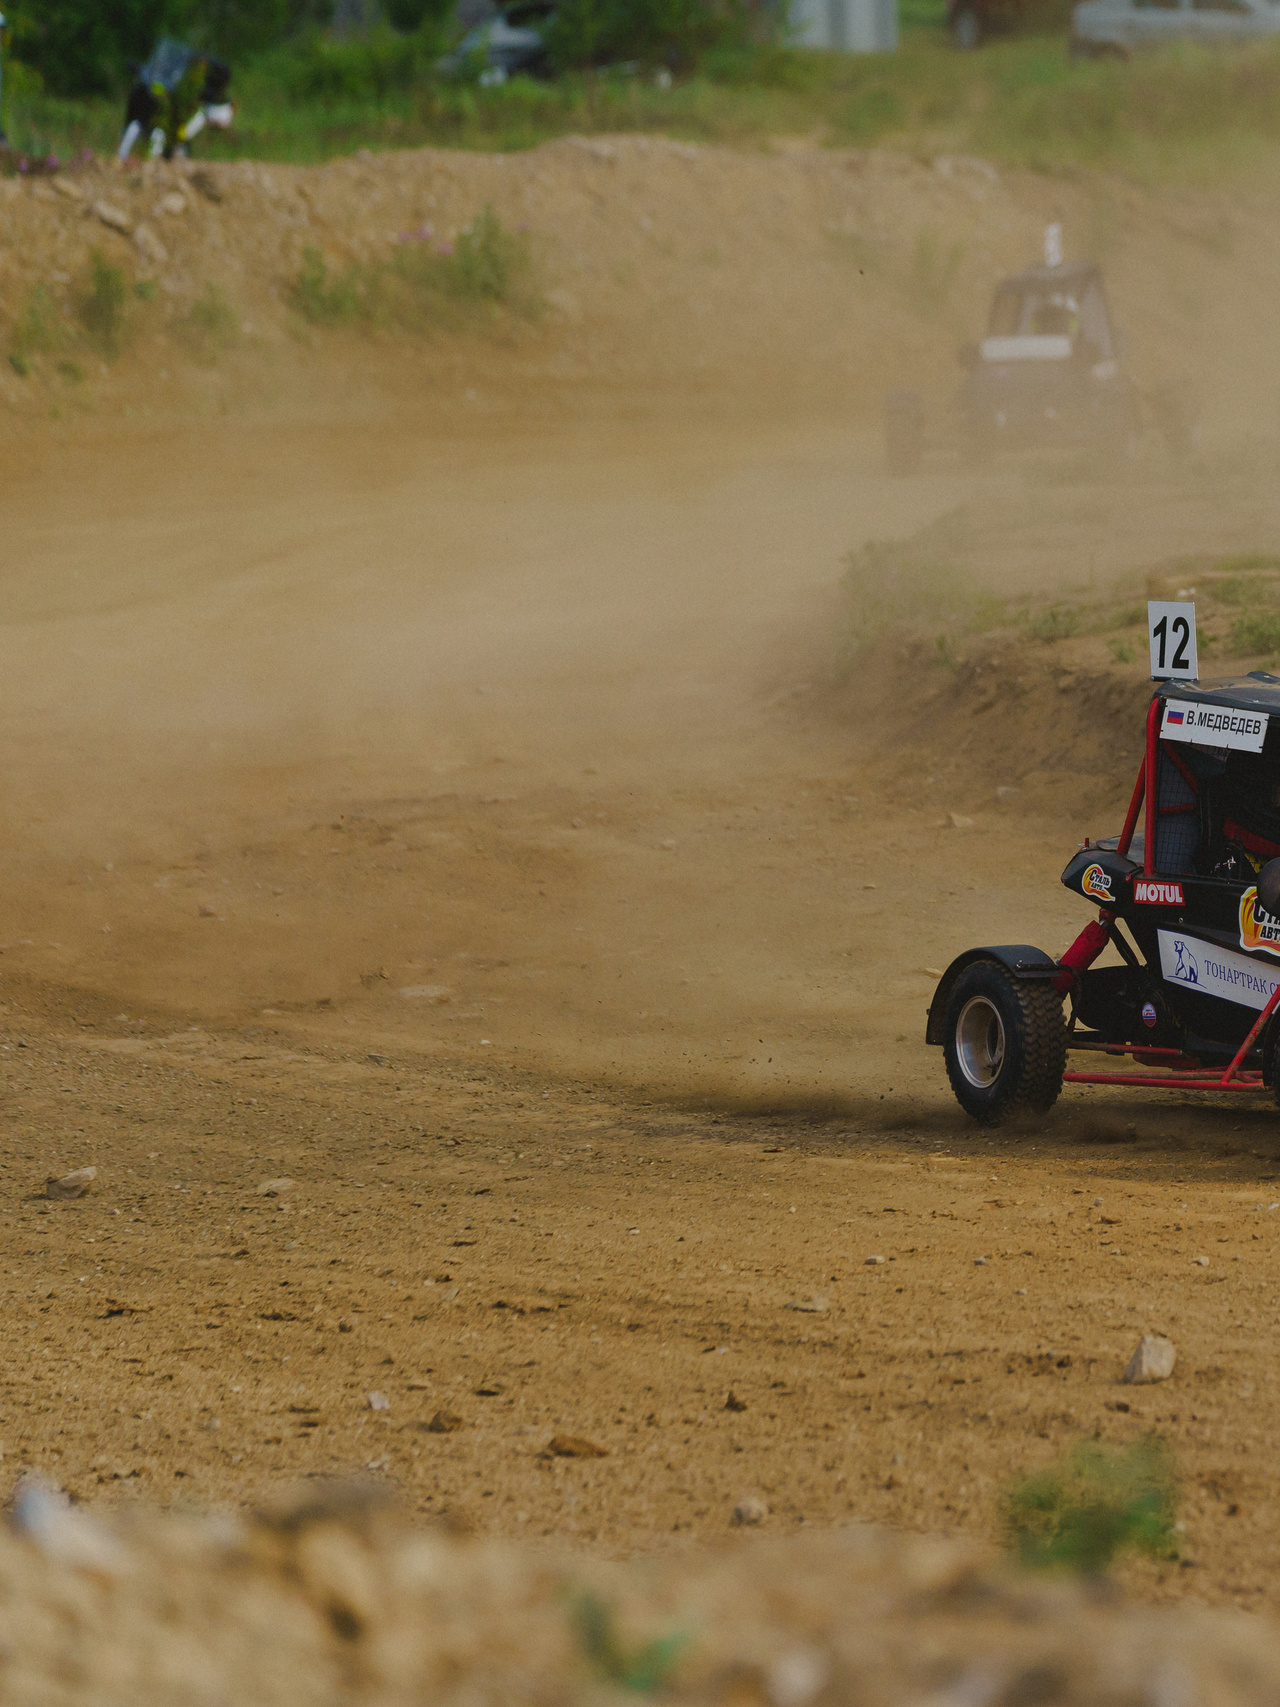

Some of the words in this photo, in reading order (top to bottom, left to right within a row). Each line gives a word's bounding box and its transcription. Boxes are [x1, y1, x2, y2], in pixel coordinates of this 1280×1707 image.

[1153, 615, 1190, 670] 12
[1186, 710, 1262, 736] В.МЕДВЕДЕВ
[1135, 883, 1183, 903] MOTUL
[1204, 959, 1268, 995] ТОНАРТРАК
